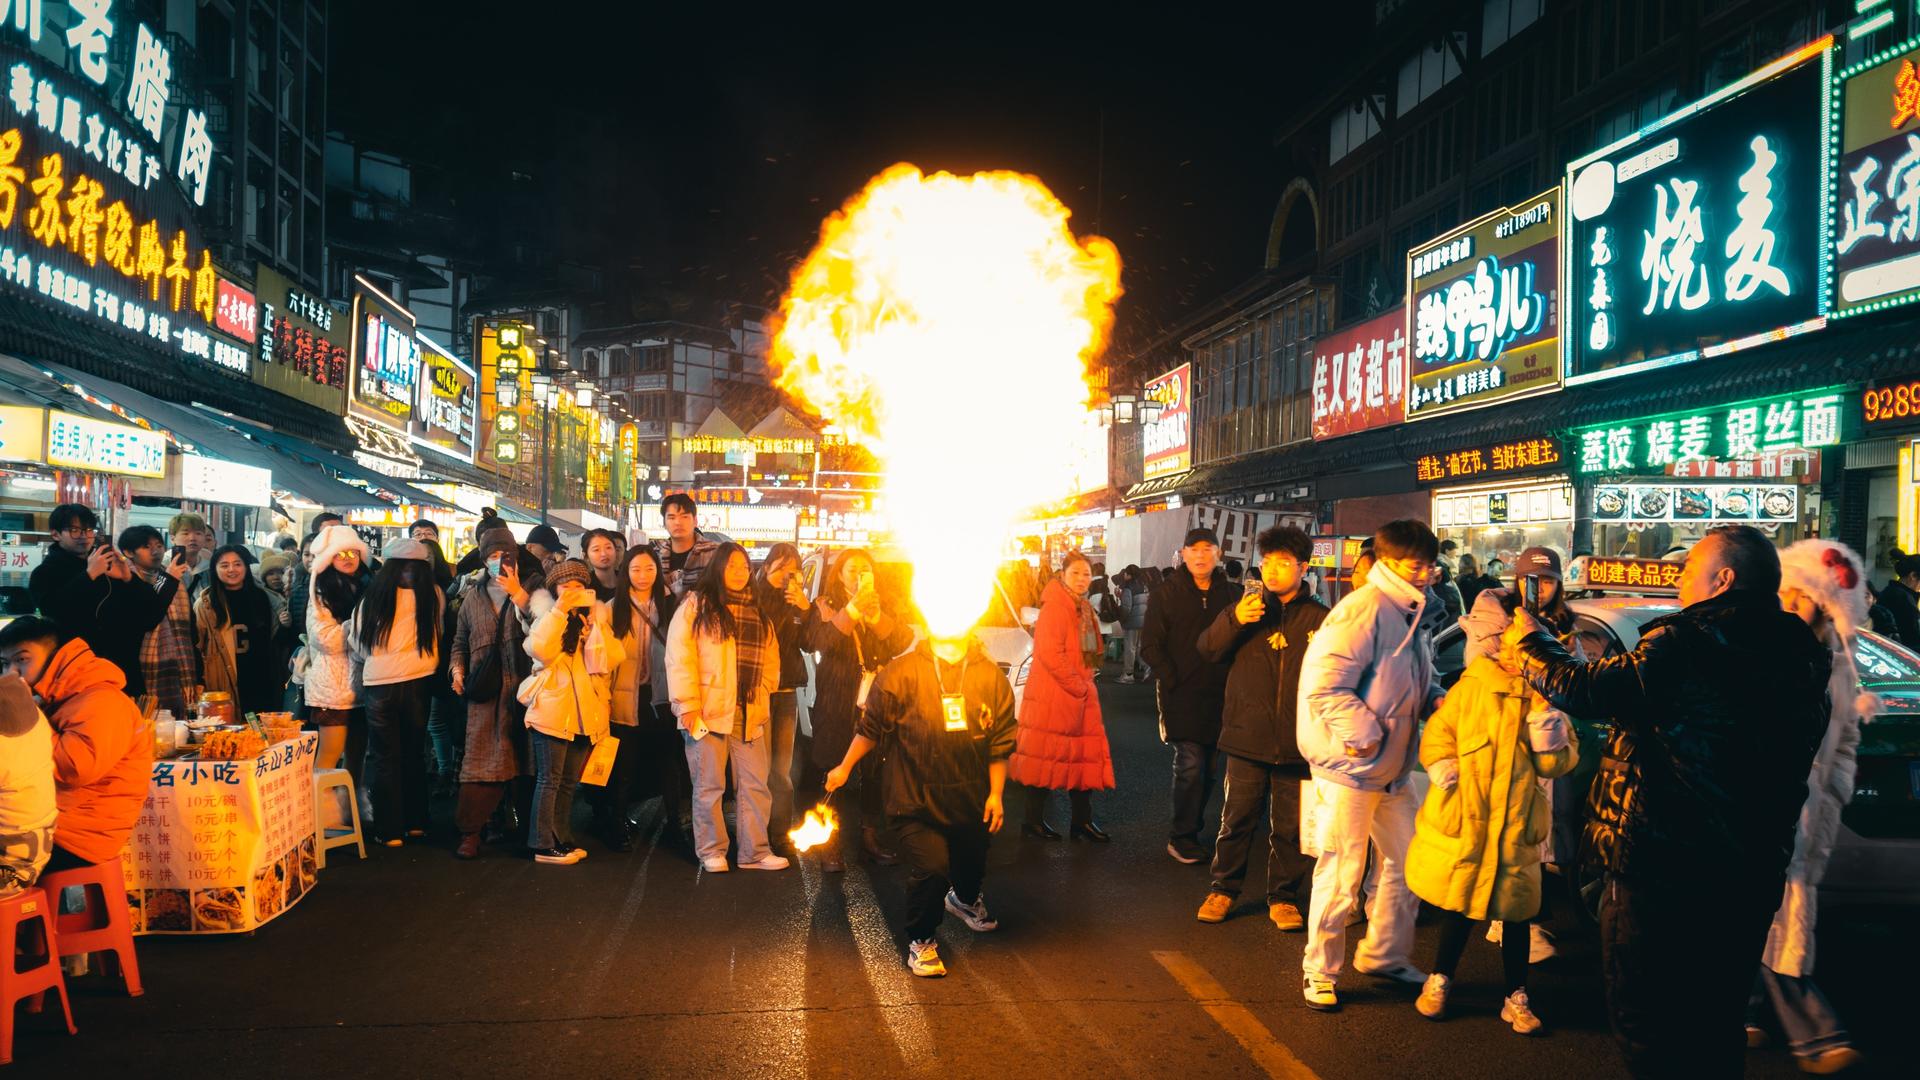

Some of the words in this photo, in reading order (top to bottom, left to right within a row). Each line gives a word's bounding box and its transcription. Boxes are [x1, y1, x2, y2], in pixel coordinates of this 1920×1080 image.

[1640, 134, 1791, 316] 烧麦
[289, 292, 333, 333] 六十年老店
[261, 302, 275, 363] 正宗
[1312, 328, 1404, 421] 佳又哆超市
[1581, 426, 1635, 473] 蒸饺
[1647, 416, 1714, 466] 烧麦
[1726, 394, 1842, 460] 银丝面
[1588, 560, 1686, 587] 创建食品安
[255, 735, 317, 778] 乐山名小吃
[152, 761, 240, 788] 名小吃
[188, 794, 237, 808] 10元/碗
[195, 812, 237, 826] 5元/串
[194, 829, 237, 844] 6元/个
[187, 847, 237, 862] 10元/个
[187, 866, 237, 881] 10元/个
